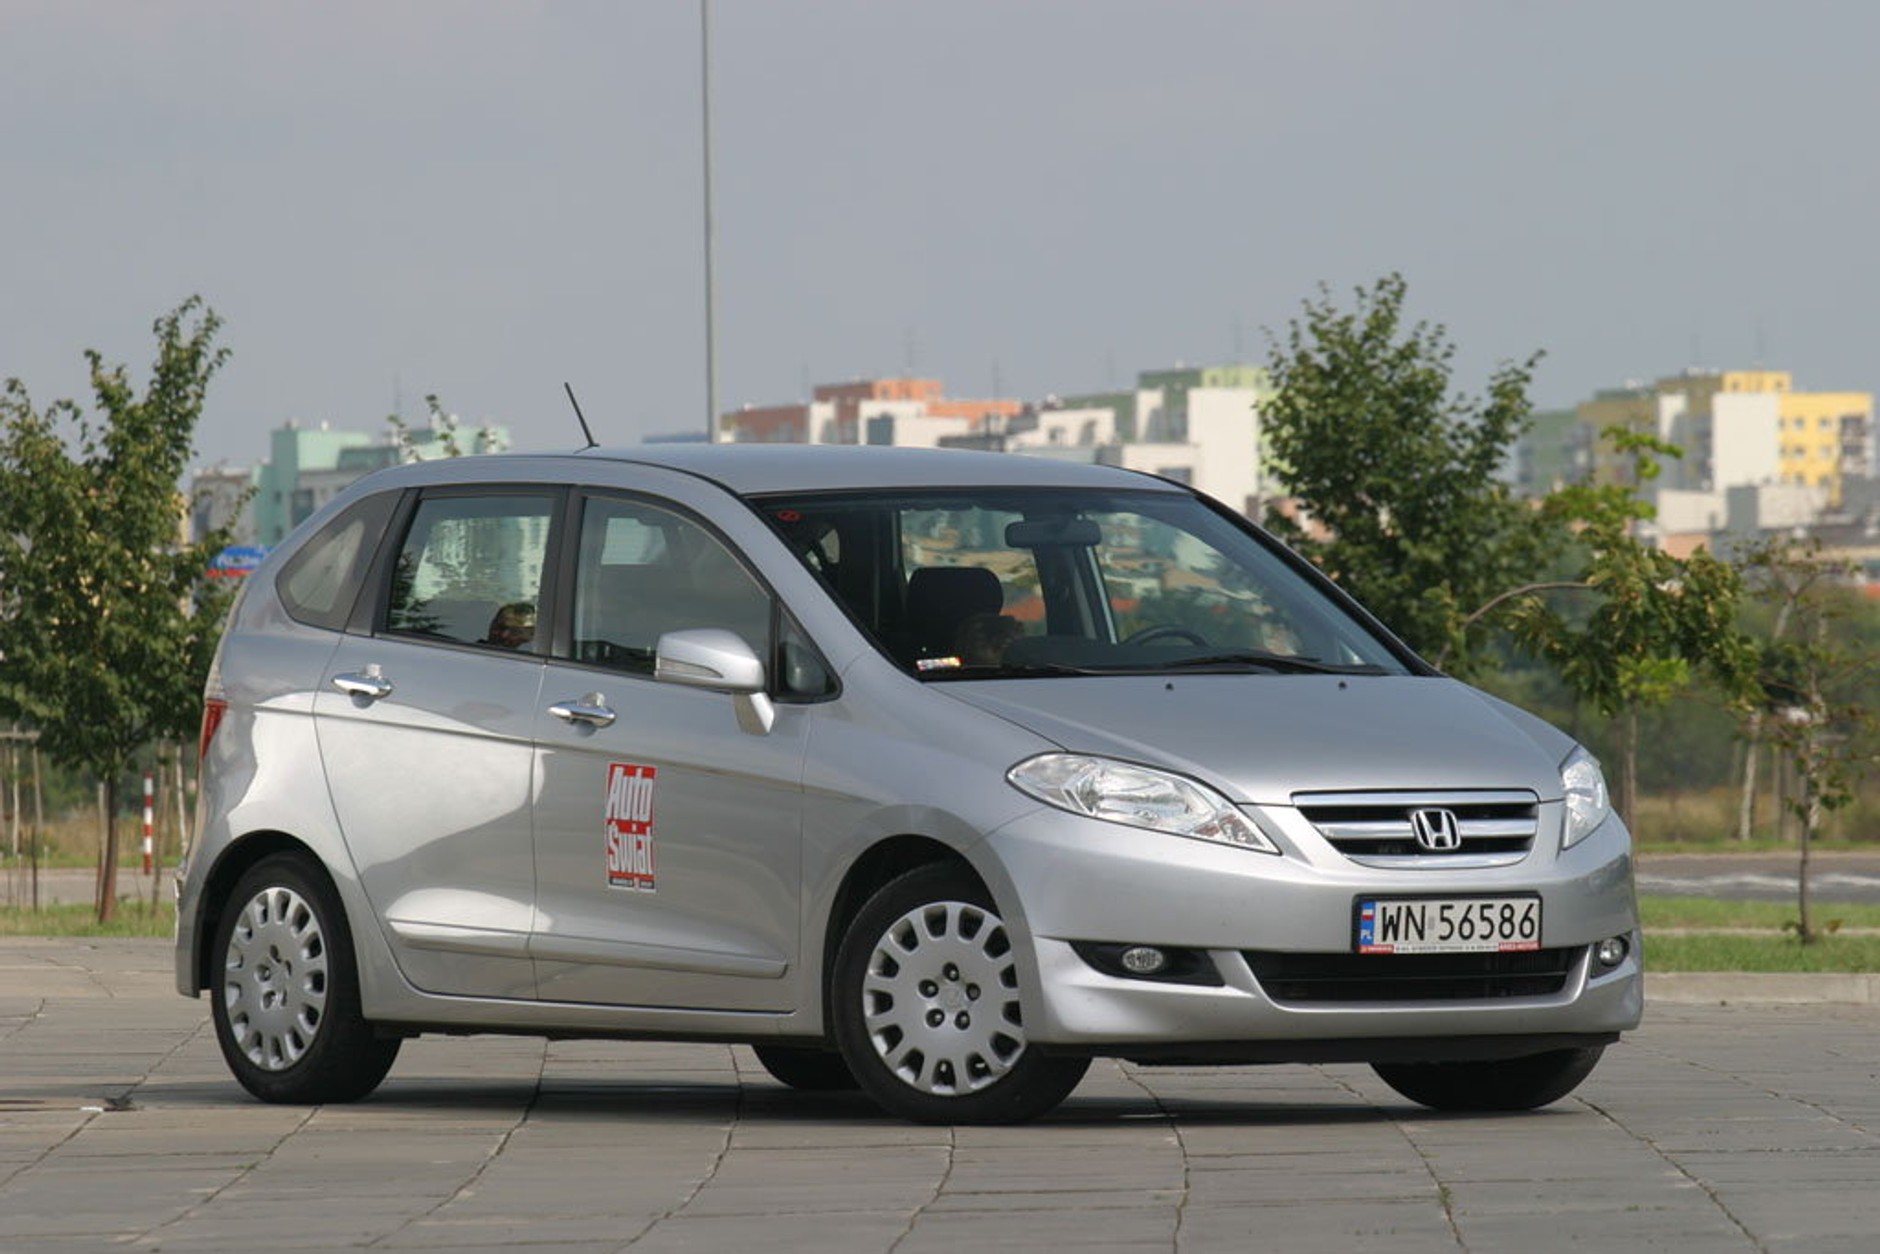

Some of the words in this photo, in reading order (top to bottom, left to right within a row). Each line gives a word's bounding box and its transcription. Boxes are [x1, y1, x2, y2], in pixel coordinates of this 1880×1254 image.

[606, 766, 654, 822] Auto
[1381, 905, 1426, 942] WN
[1438, 903, 1536, 941] 56586
